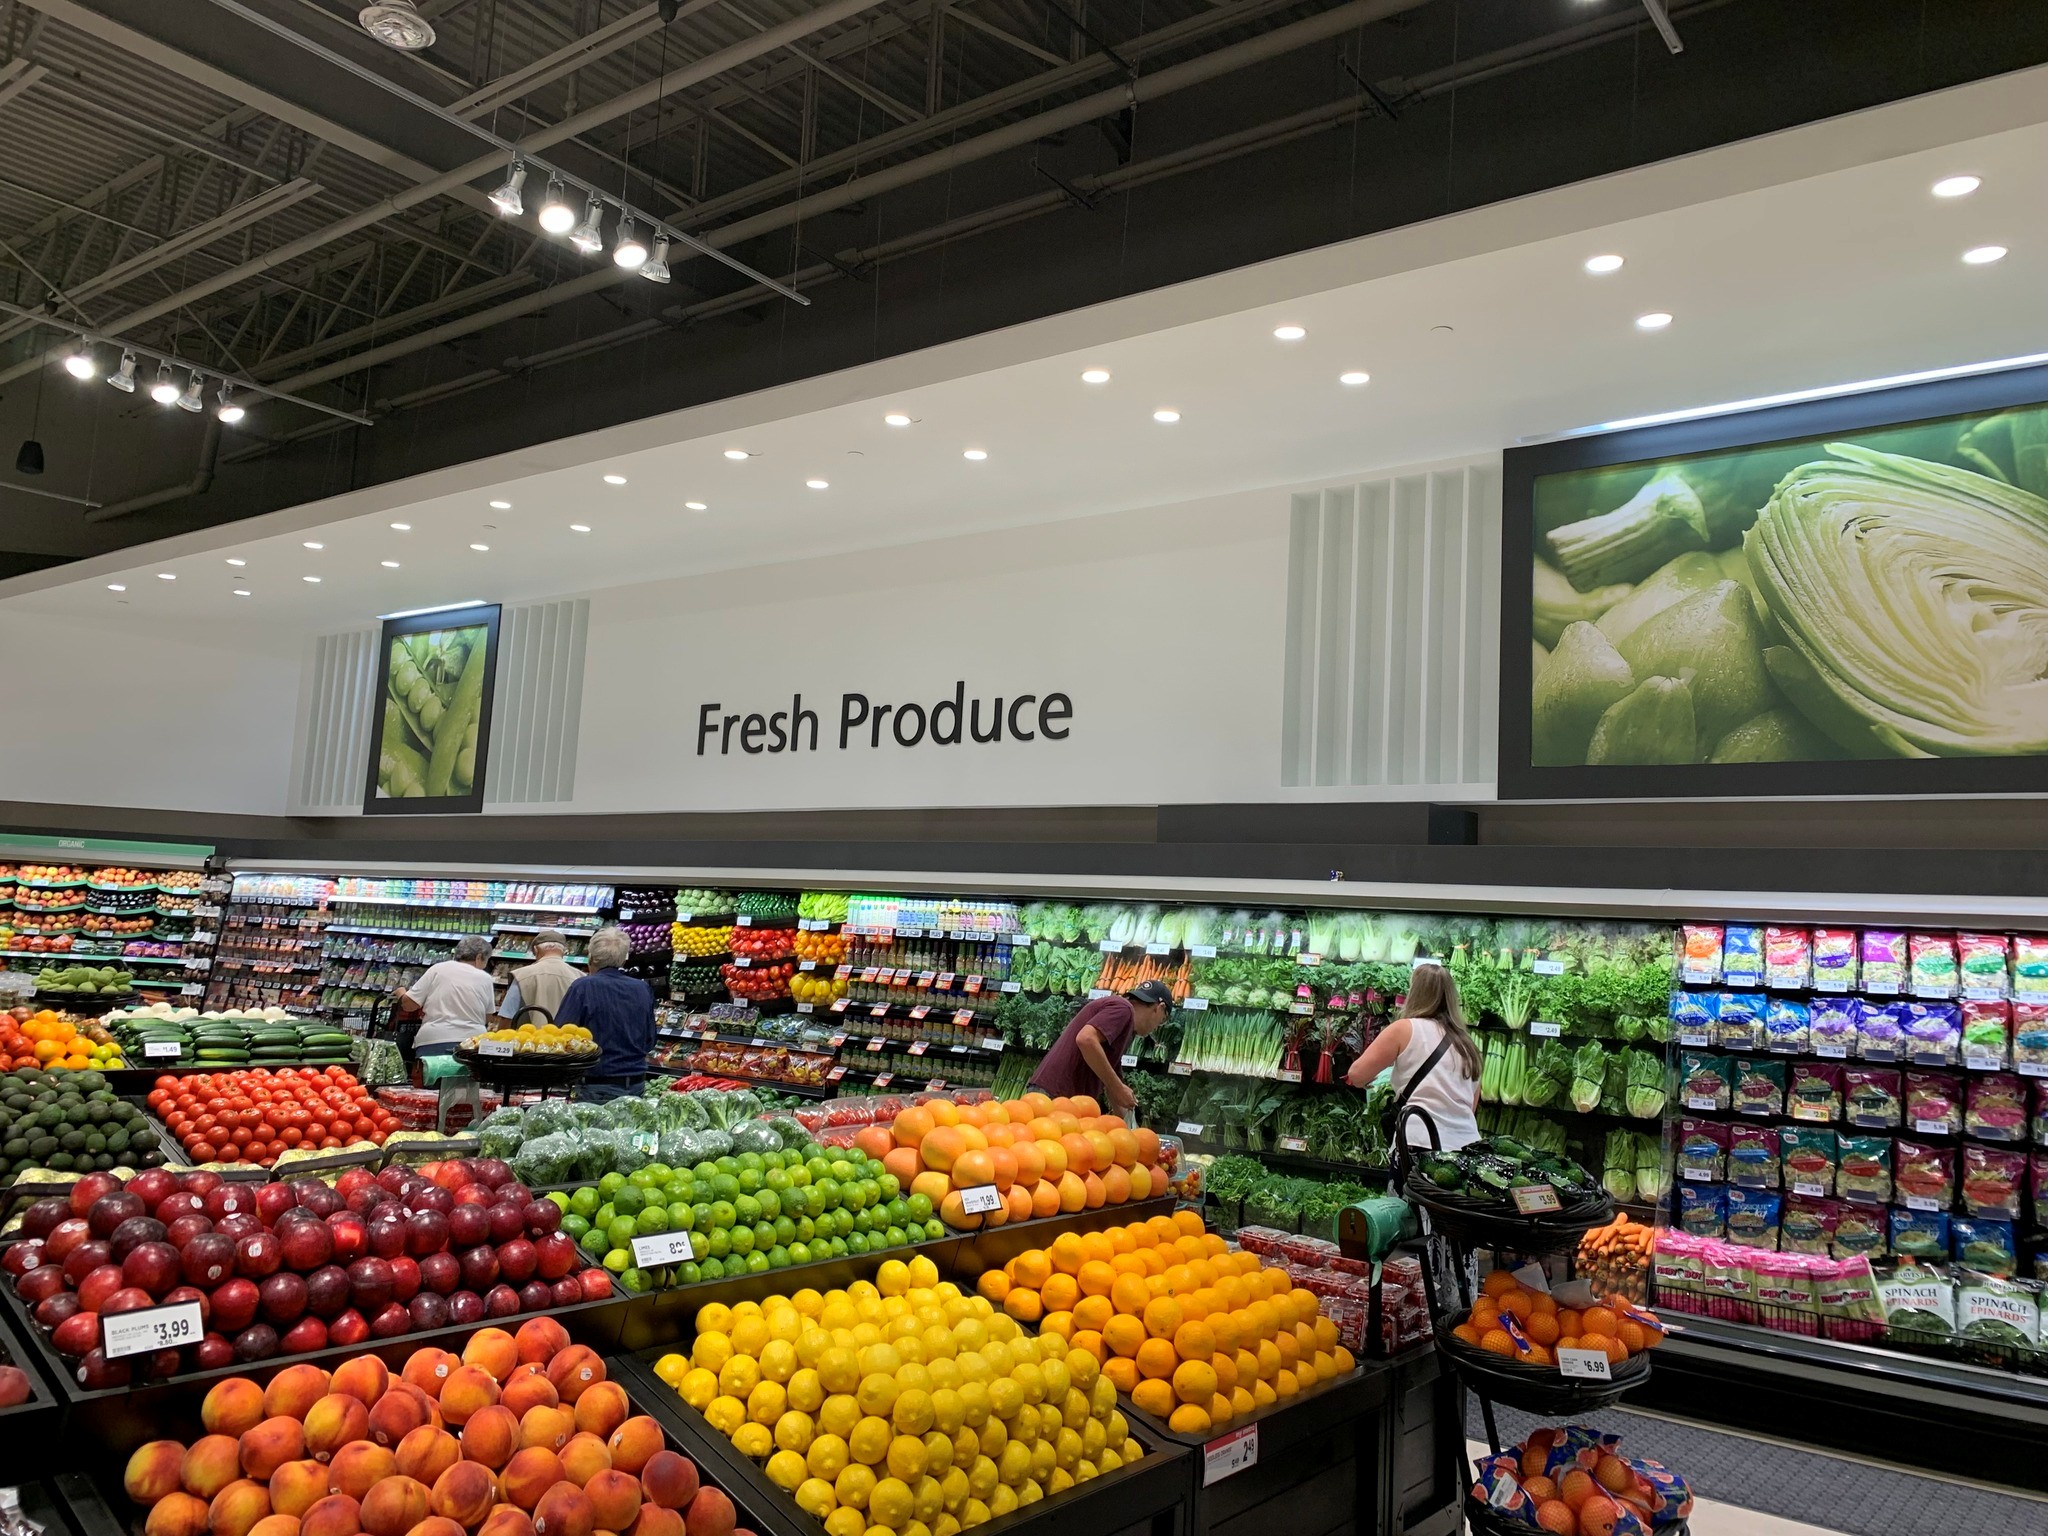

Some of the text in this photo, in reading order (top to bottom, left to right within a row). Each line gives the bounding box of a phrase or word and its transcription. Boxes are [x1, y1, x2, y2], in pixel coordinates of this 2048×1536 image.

[697, 680, 1074, 756] Fresh Produce
[58, 839, 85, 848] ORGANIC
[495, 1046, 510, 1054] $2.29
[1885, 1288, 1937, 1297] SPINACH
[1971, 1296, 2027, 1315] SPINACH
[153, 1319, 189, 1340] $3.99
[1584, 1360, 1605, 1373] $6.99
